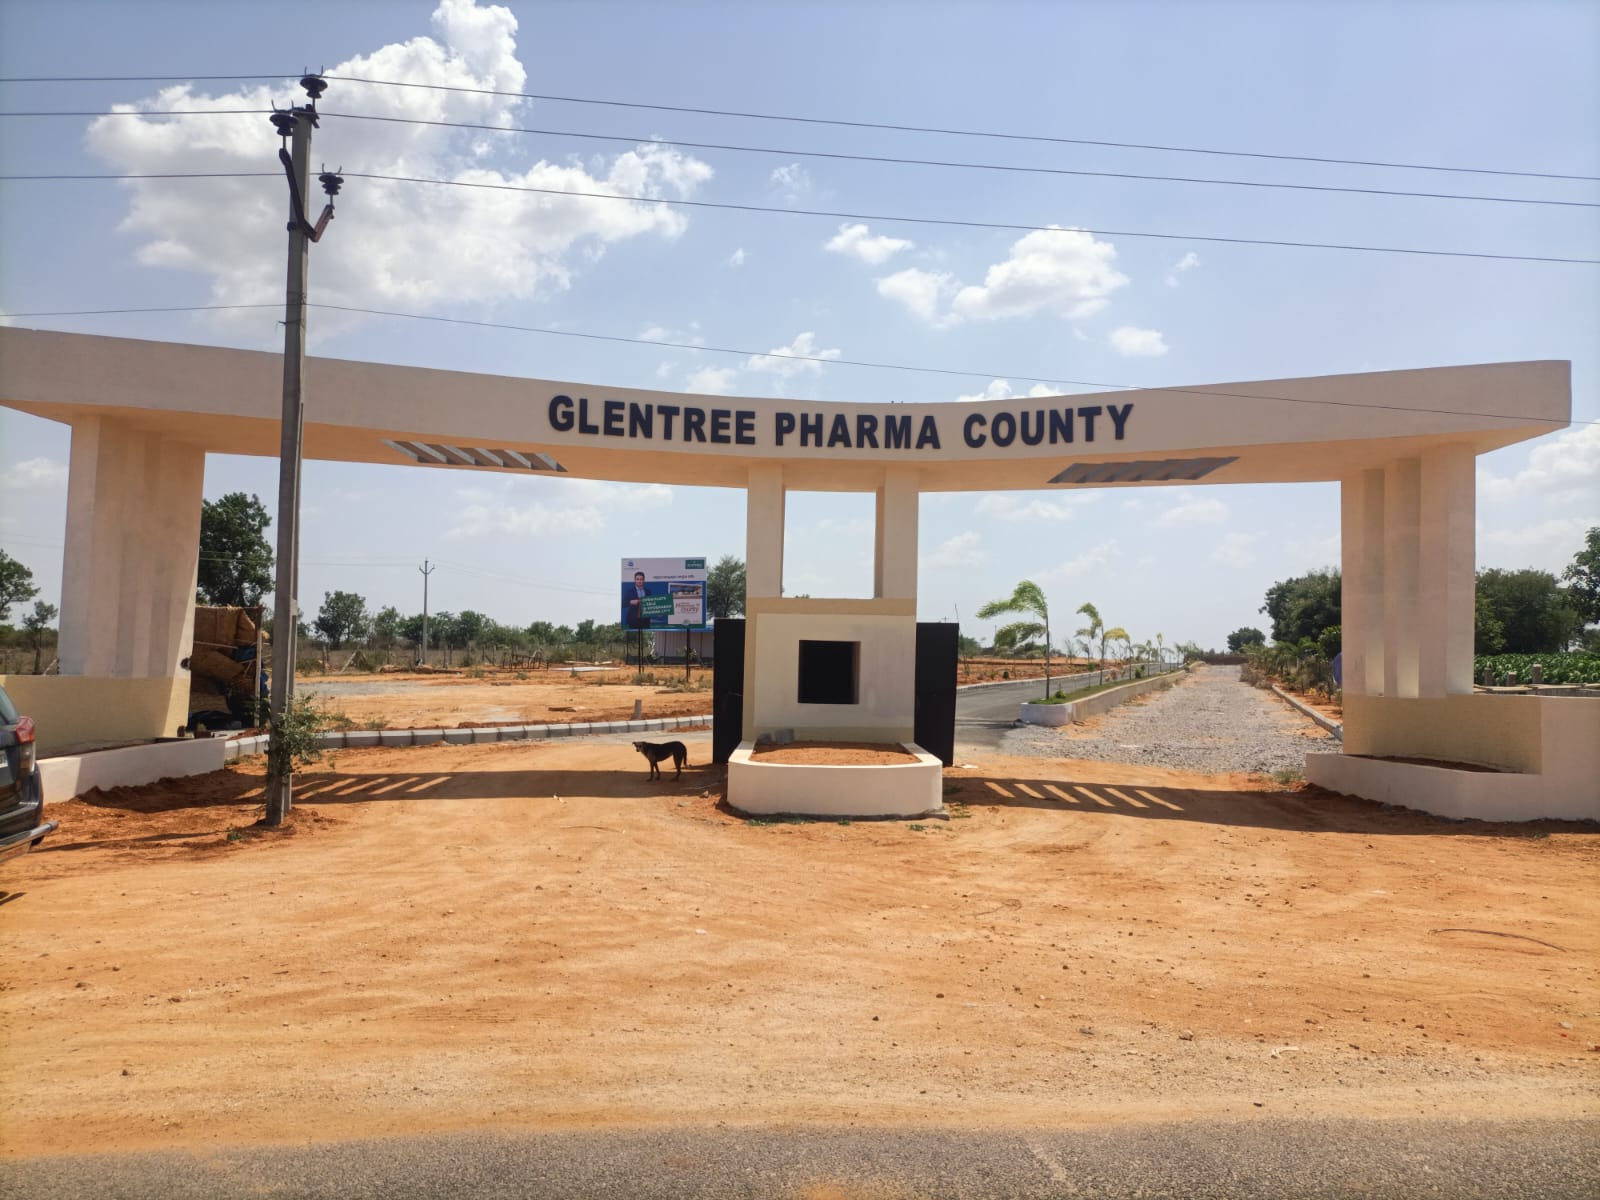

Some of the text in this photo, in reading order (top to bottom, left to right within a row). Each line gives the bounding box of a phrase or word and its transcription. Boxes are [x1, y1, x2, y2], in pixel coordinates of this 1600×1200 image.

[547, 394, 1135, 450] GLENTREE PHARMA COUNTY
